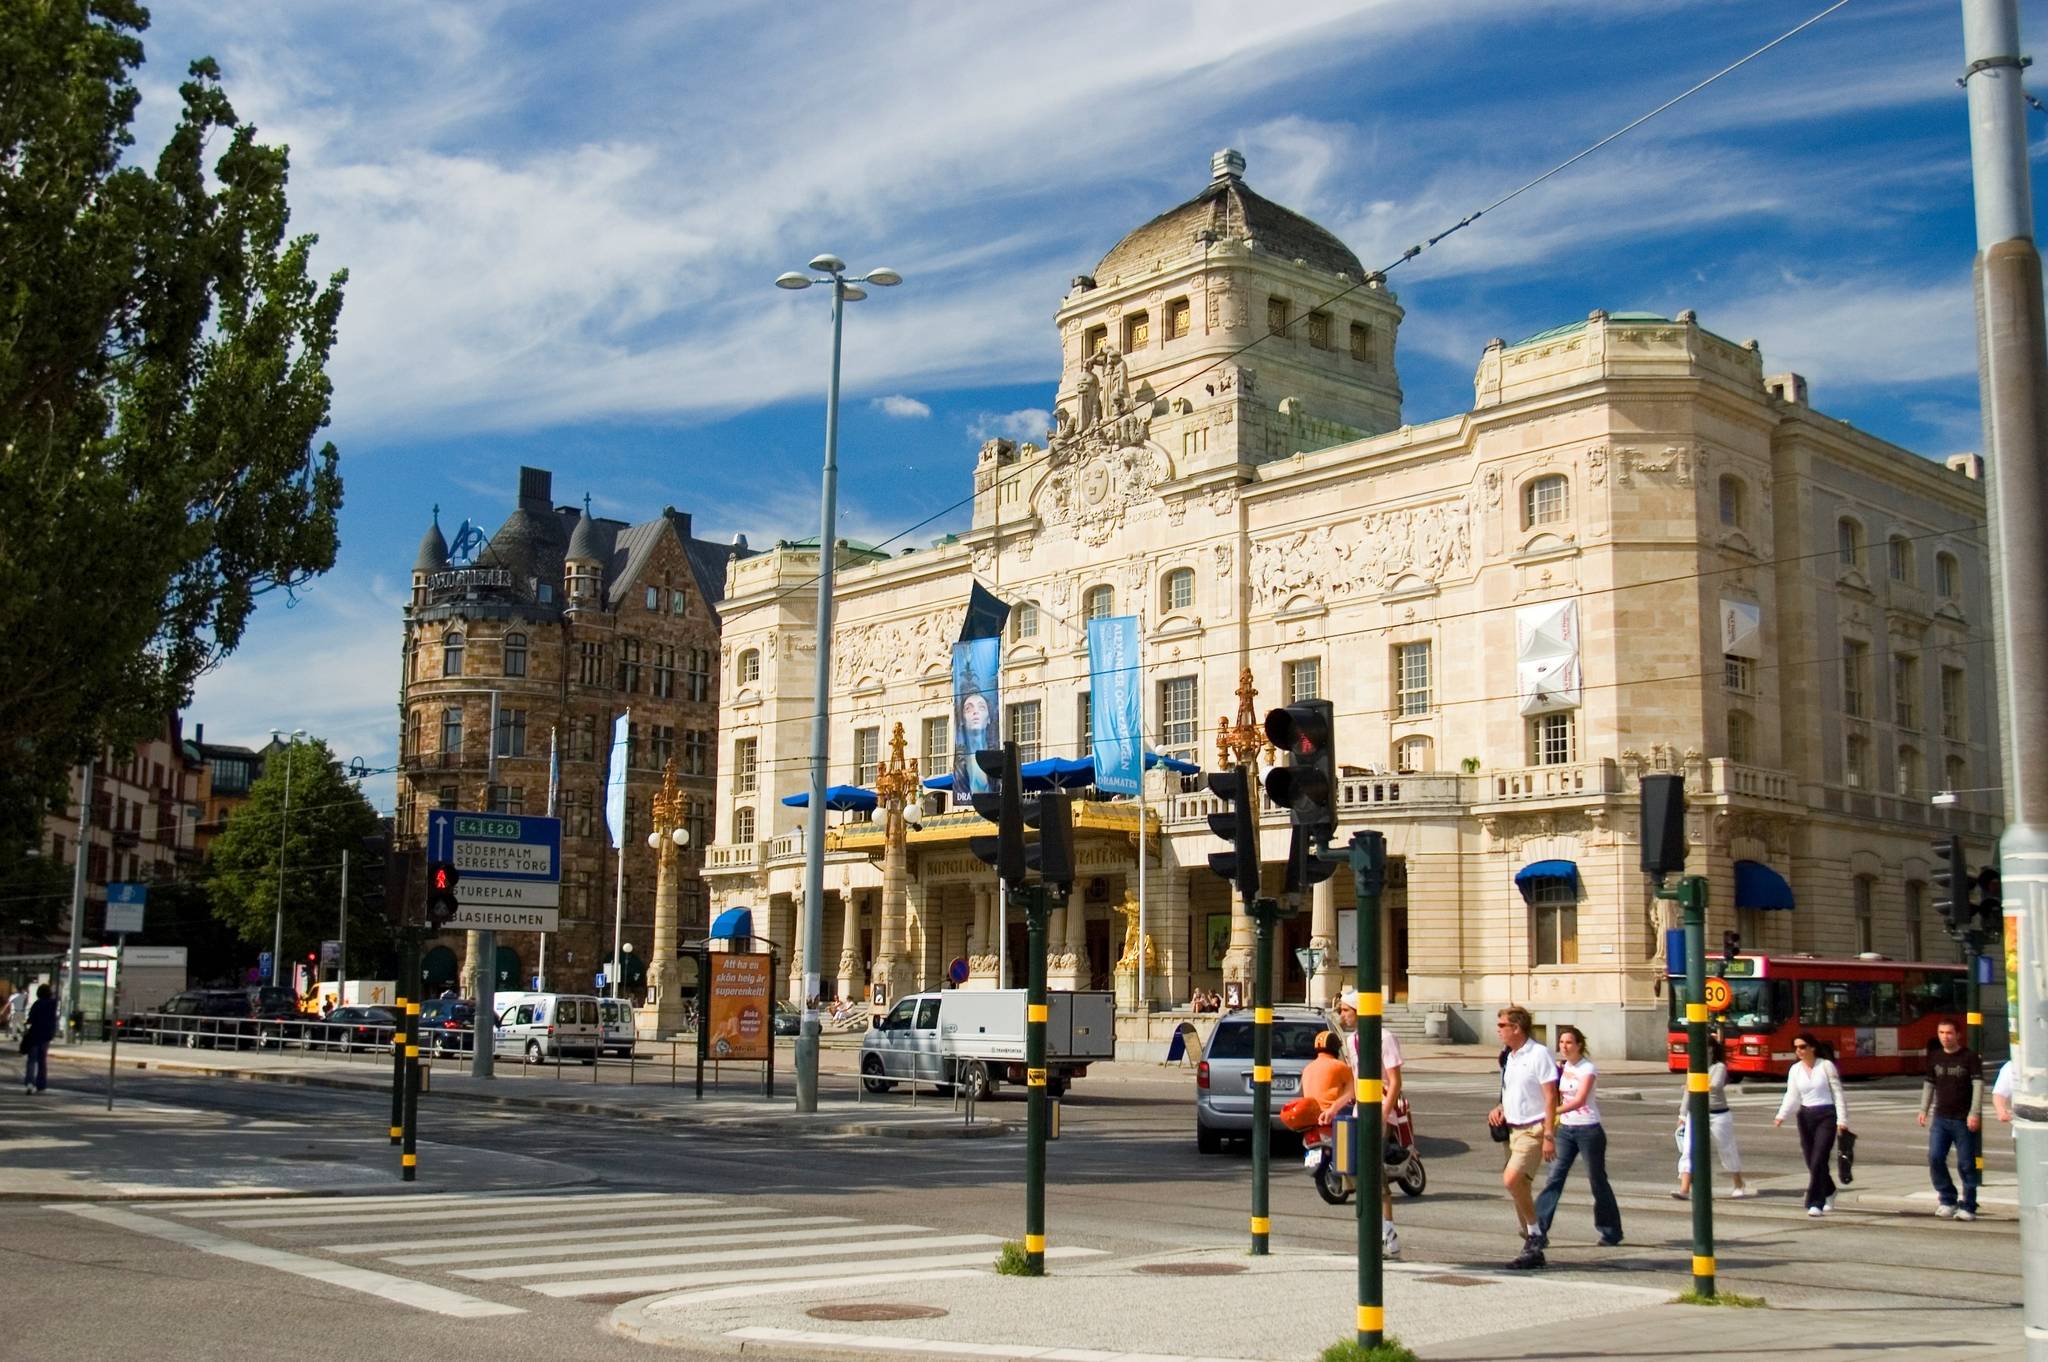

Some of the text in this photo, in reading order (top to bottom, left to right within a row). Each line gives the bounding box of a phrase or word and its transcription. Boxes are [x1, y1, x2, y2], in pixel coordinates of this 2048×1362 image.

[457, 843, 531, 859] SÖDERMALM
[456, 858, 547, 872] SERGELS TORG
[452, 886, 523, 899] STUREPLAN
[1705, 986, 1725, 1002] 30
